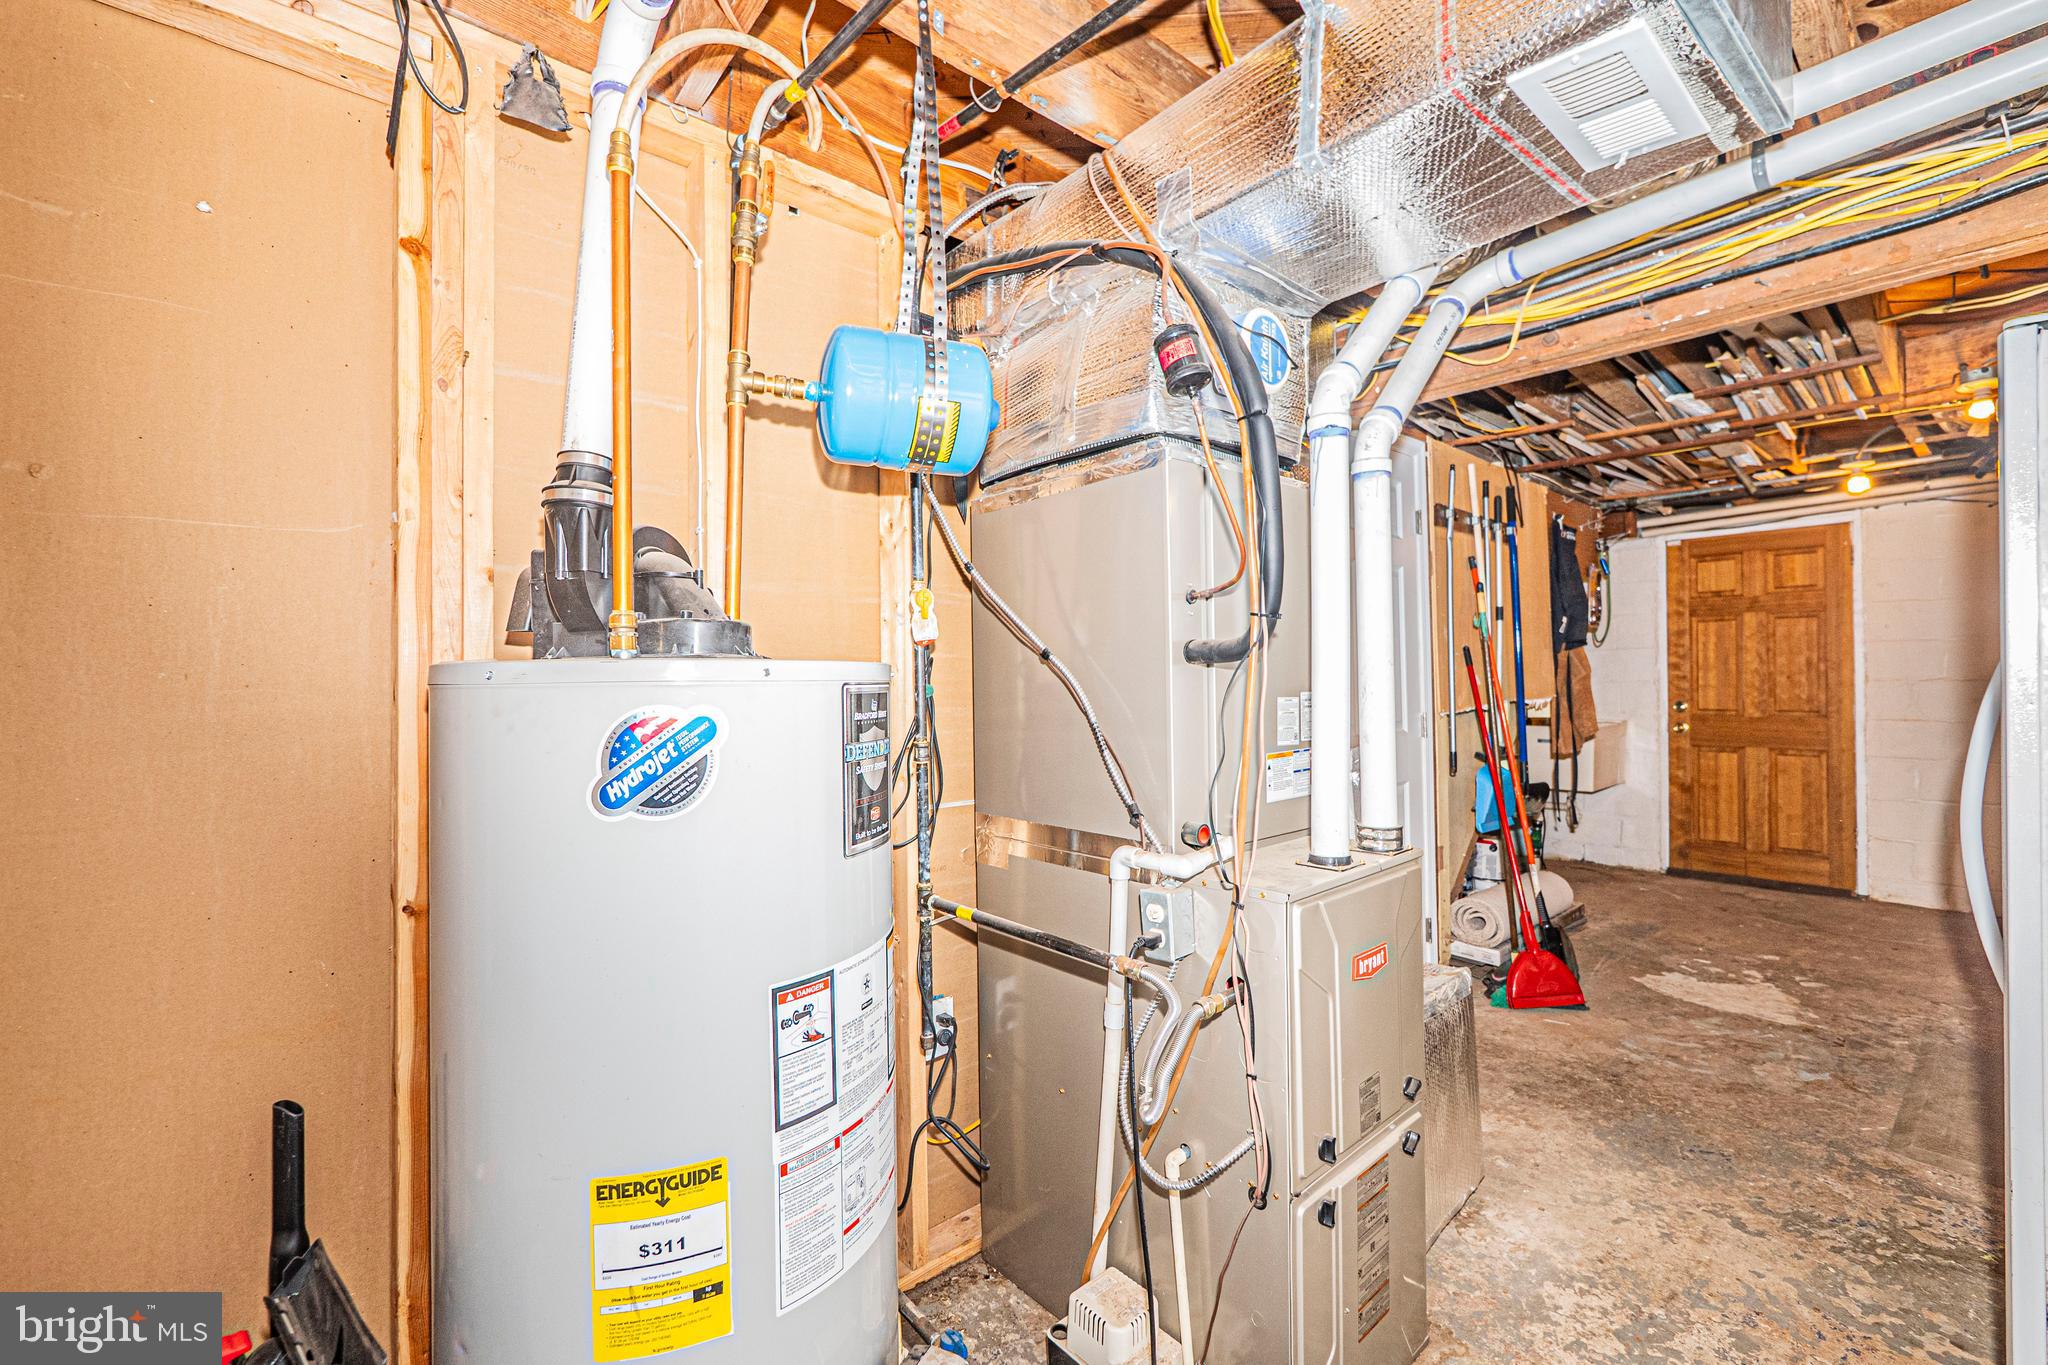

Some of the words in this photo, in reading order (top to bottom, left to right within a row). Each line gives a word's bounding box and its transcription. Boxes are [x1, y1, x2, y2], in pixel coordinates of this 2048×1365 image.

[1261, 361, 1269, 379] Air
[619, 743, 654, 770] EQUIPPED
[658, 727, 676, 740] WITH
[606, 741, 678, 802] Hydrojet
[650, 761, 690, 792] FEATURING
[1359, 949, 1385, 975] bryant
[796, 982, 825, 997] DANGER
[596, 1164, 722, 1201] ENERGYGUIDE
[630, 1221, 651, 1230] Estimated
[652, 1219, 665, 1227] Yearly
[666, 1216, 680, 1225] Energy
[639, 1236, 685, 1259] $311
